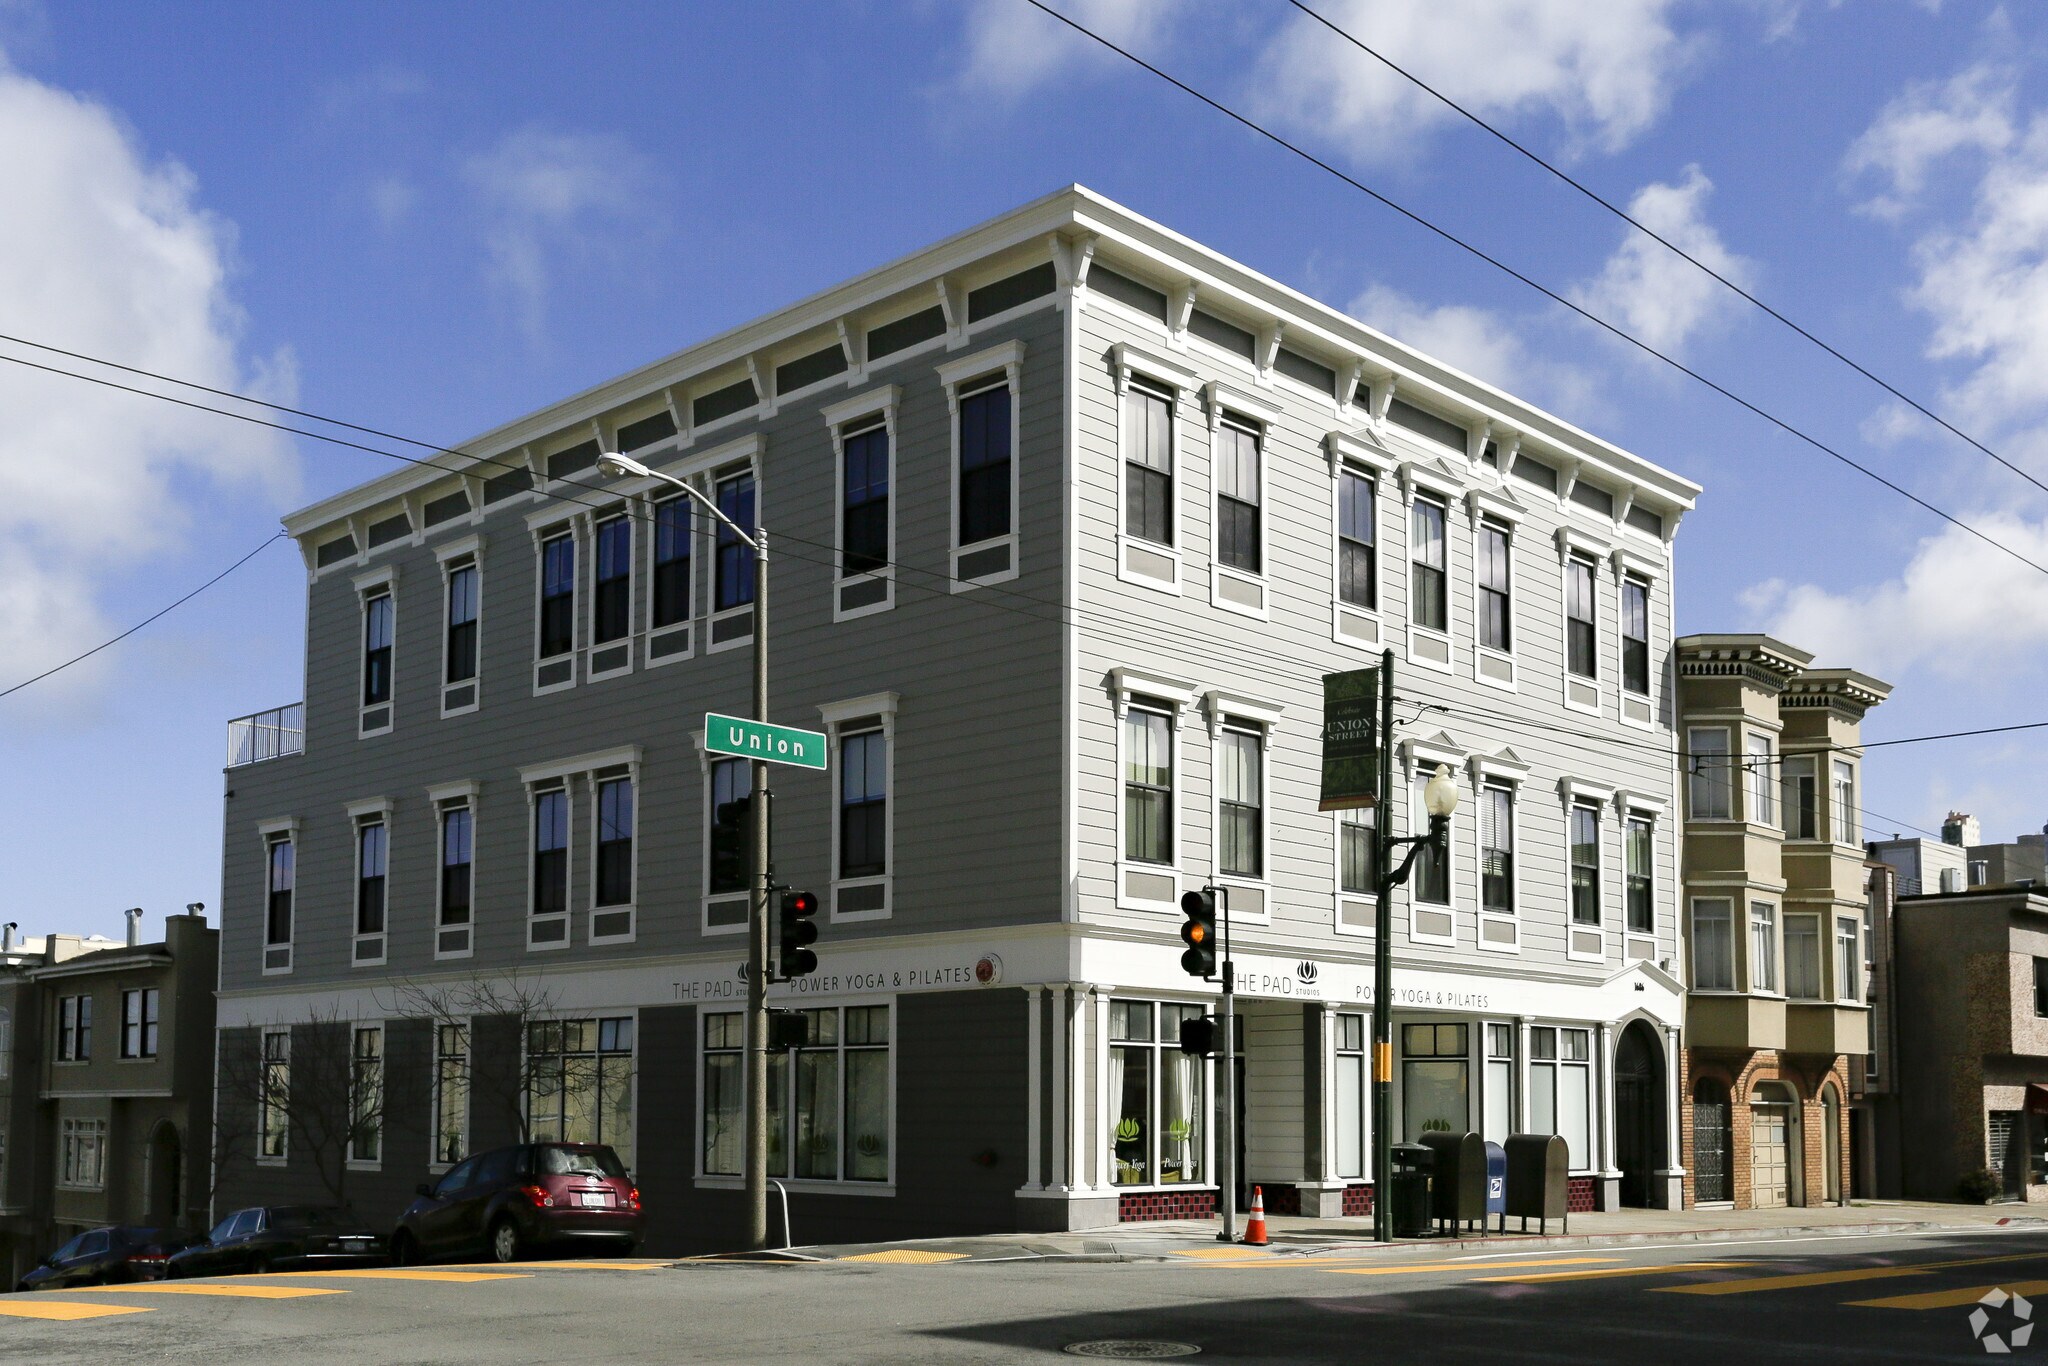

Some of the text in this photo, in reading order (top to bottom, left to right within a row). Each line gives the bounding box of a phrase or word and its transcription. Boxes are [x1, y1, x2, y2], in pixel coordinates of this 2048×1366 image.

[1327, 717, 1371, 732] UNION
[729, 726, 804, 757] Union
[1328, 730, 1369, 741] STREET
[790, 967, 971, 993] POWER YOGA & PILATES
[1236, 973, 1292, 994] HE PAD
[673, 982, 699, 999] THE
[704, 980, 732, 997] PAD
[1295, 988, 1320, 996] STUDIOS
[1356, 985, 1489, 1008] POR YOGA & PILATES
[1131, 1158, 1146, 1171] Yoga
[1164, 1157, 1183, 1168] Power
